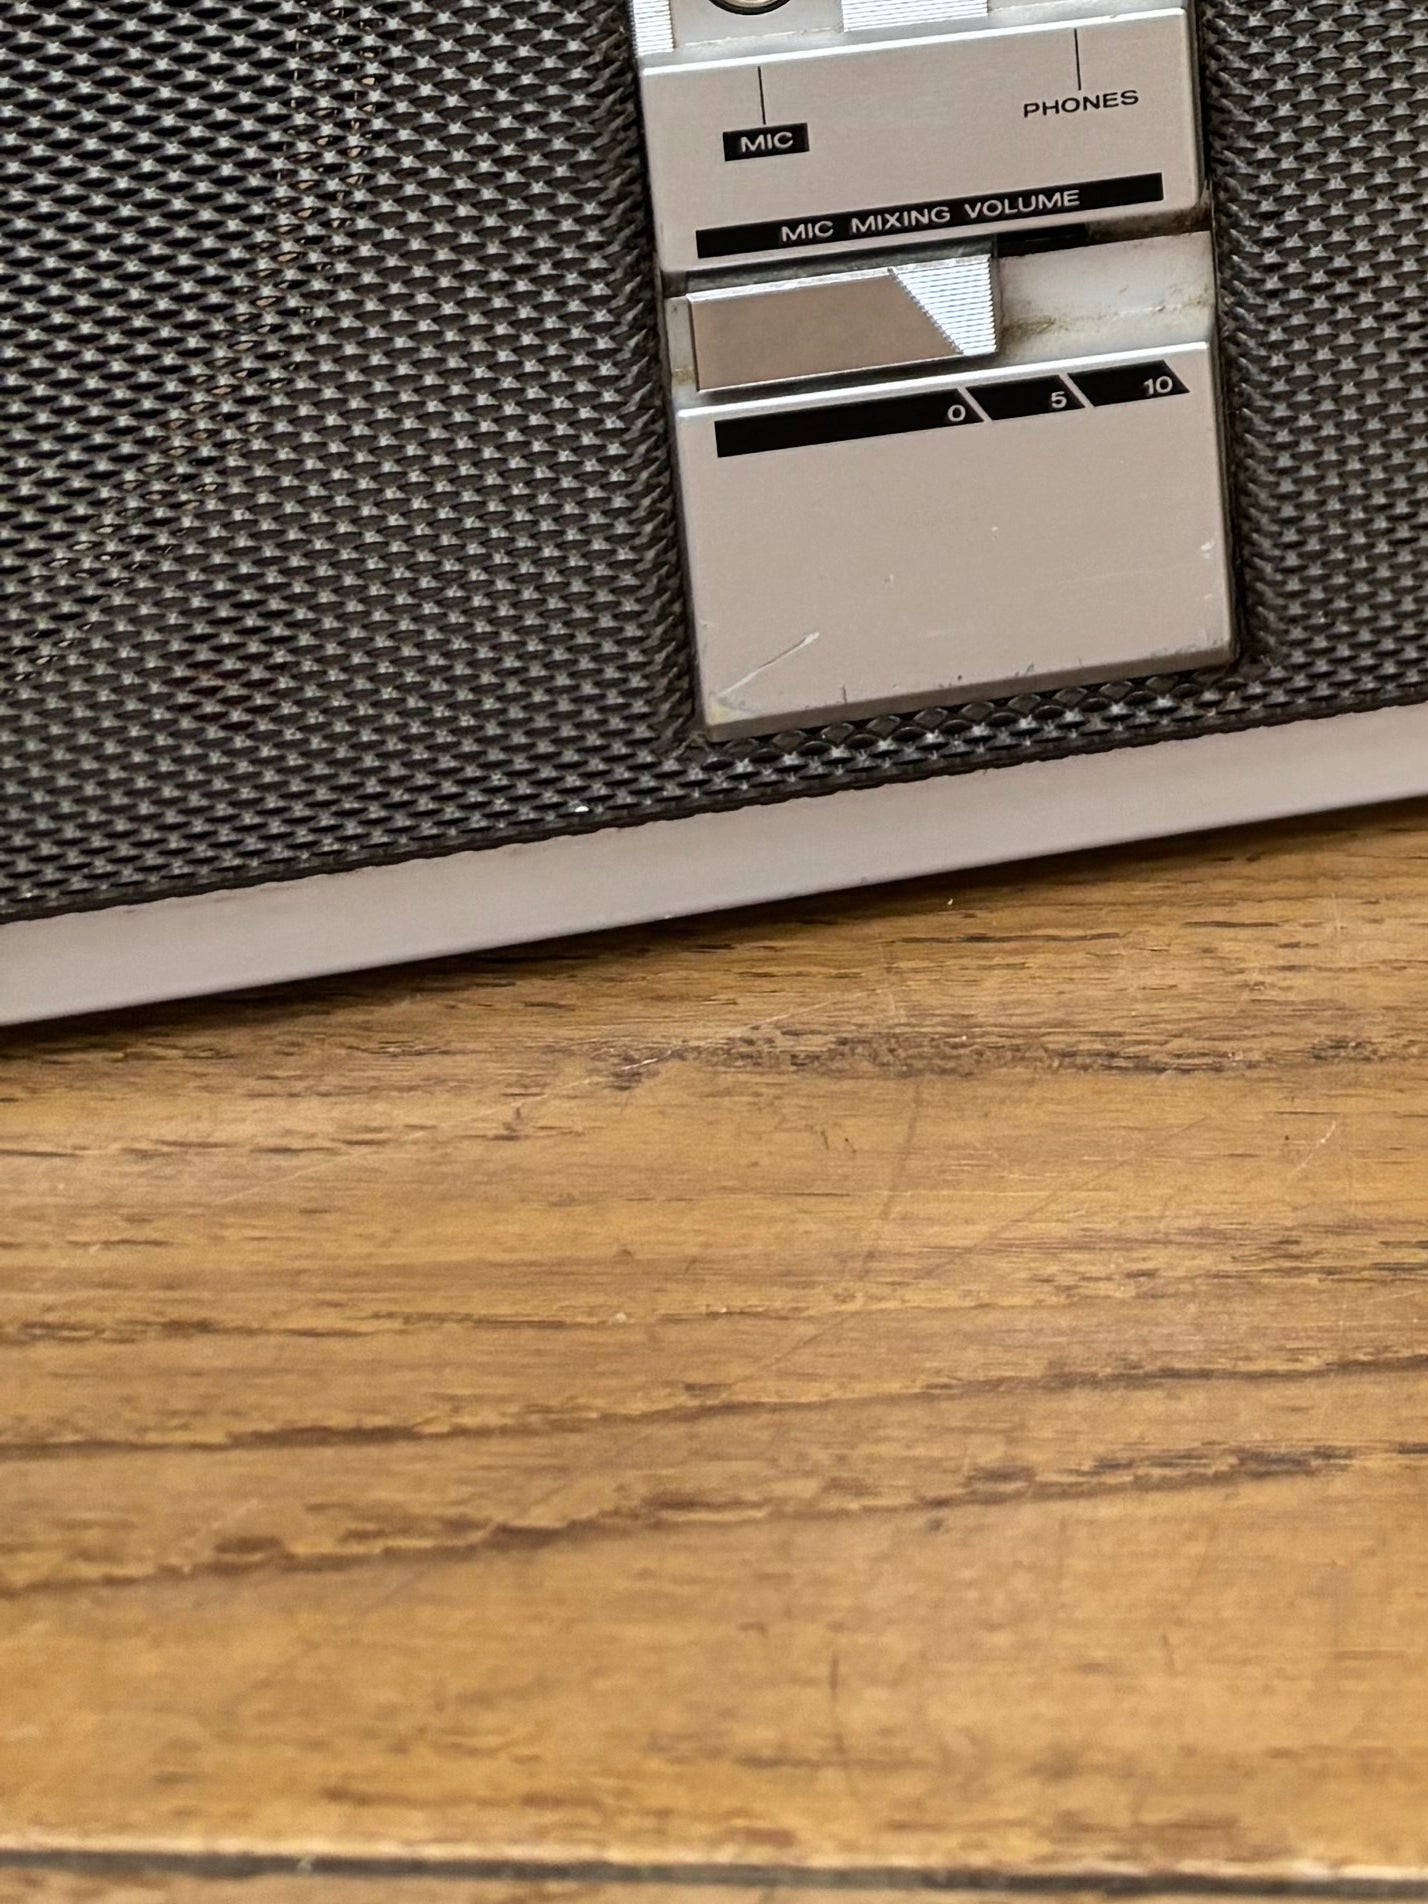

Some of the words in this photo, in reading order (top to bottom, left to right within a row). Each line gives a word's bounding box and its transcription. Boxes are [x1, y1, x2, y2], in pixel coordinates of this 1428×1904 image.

[1022, 89, 1141, 119] PHONES
[740, 130, 795, 155] MIC
[780, 221, 835, 244] MIC
[851, 206, 952, 235] MIXING
[964, 190, 1082, 220] VOLUME
[1143, 375, 1174, 397] 10
[1050, 391, 1068, 411] 5
[947, 403, 966, 424] 0
